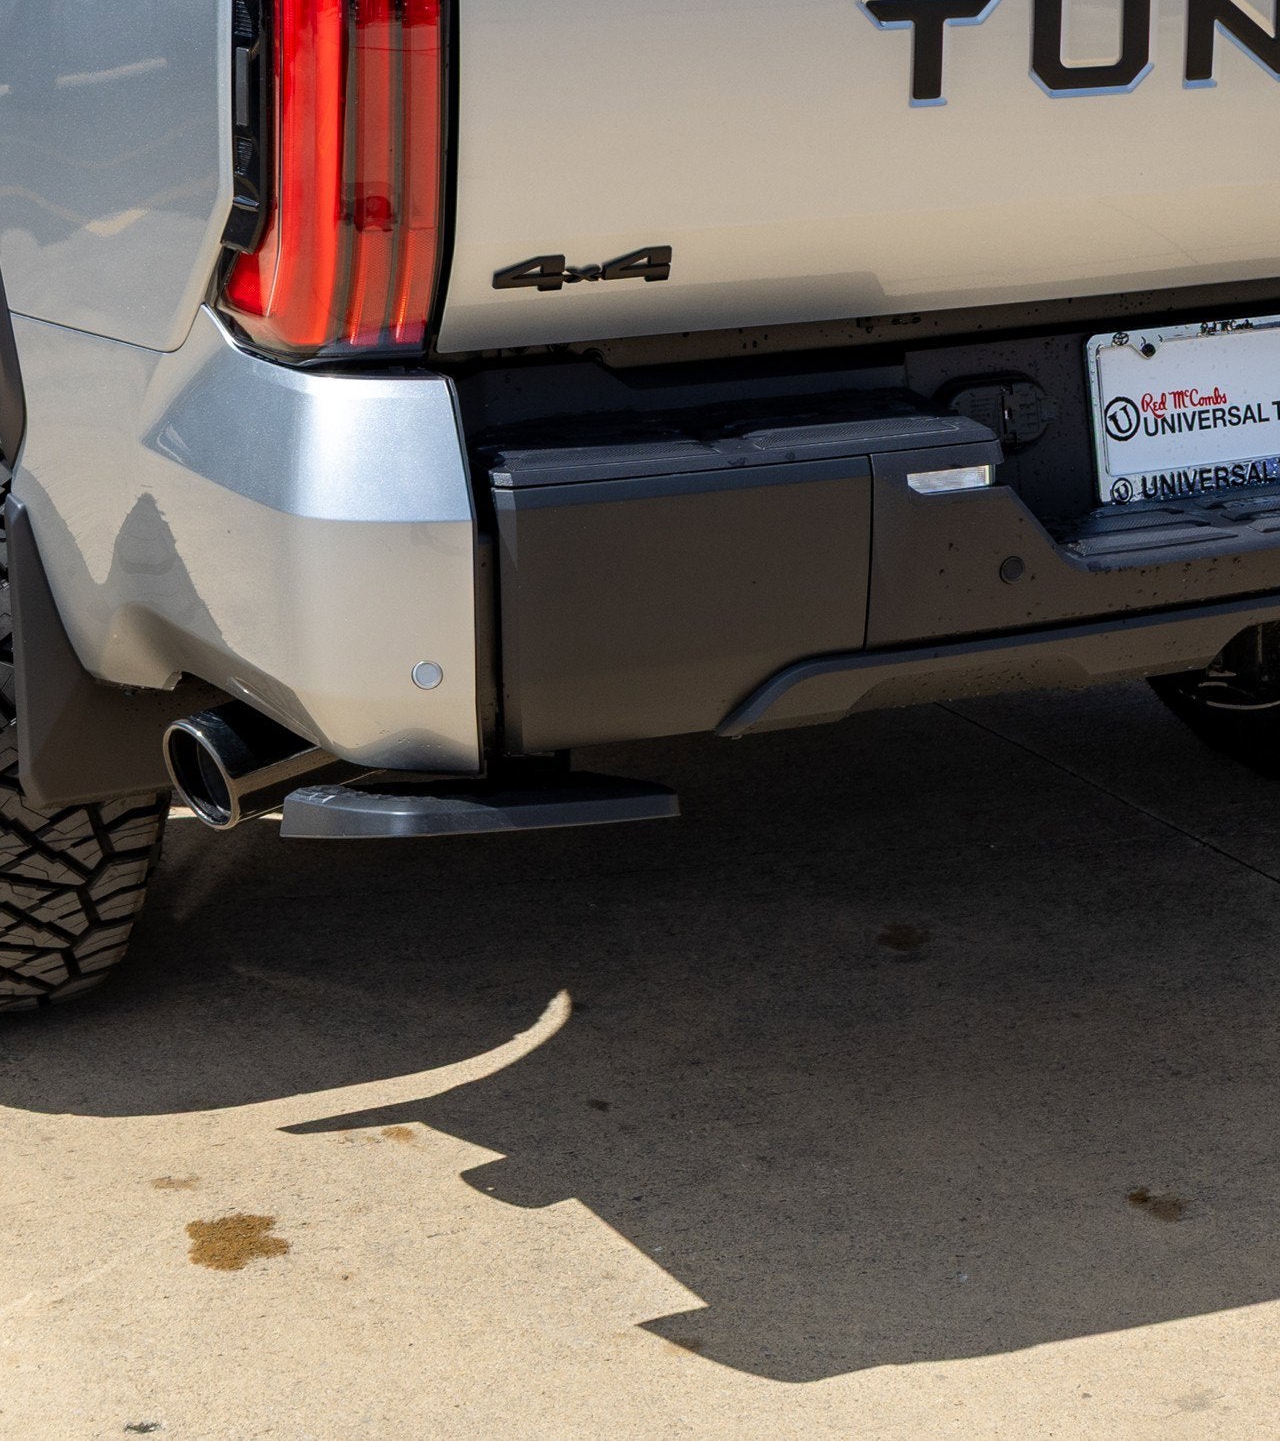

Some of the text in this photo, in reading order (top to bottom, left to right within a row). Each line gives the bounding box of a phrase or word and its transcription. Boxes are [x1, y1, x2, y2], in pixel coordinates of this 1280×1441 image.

[1141, 387, 1228, 419] Red McCombs
[1143, 402, 1270, 437] UNIVERSAL
[1141, 459, 1275, 498] UNIVERSAL
